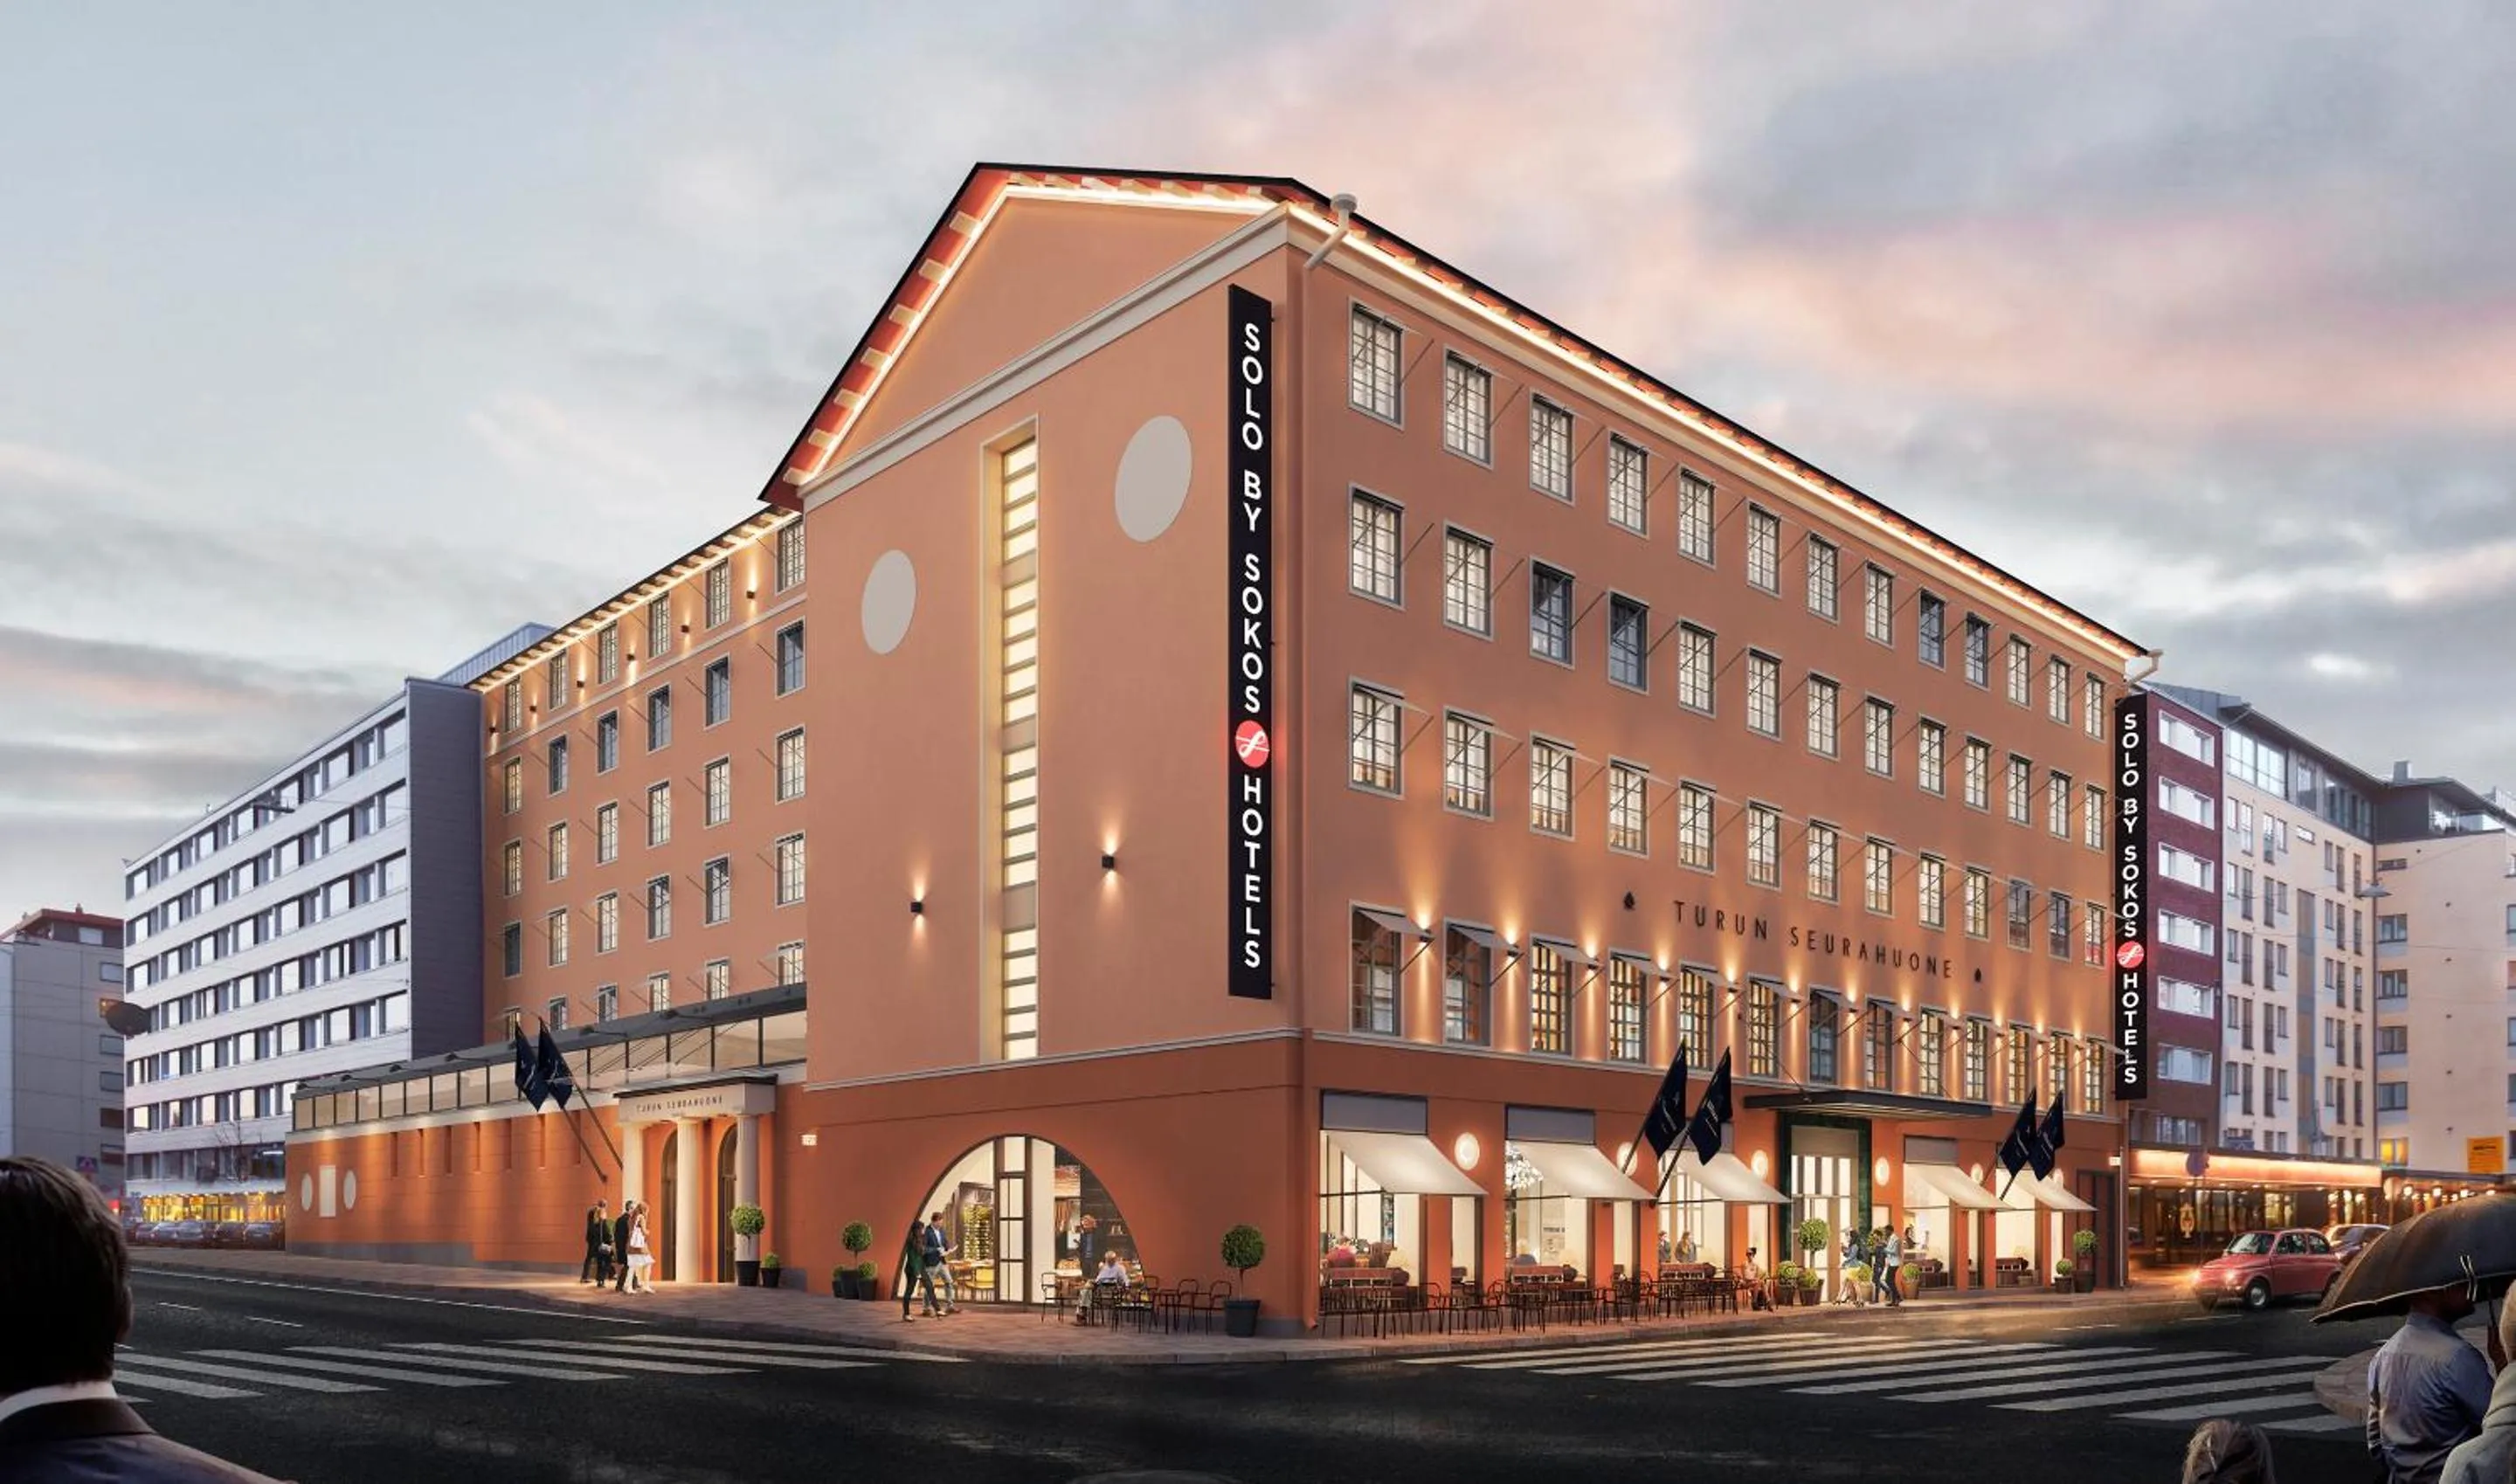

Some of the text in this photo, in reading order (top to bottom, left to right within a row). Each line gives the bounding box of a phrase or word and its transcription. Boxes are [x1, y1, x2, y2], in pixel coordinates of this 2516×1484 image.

[1241, 322, 1263, 969] SOLO BY SOKOS HOTELS
[1674, 900, 1953, 979] TURUN SEURAHUONE
[2121, 713, 2139, 1084] SOLO BY SOKOS HOTELS
